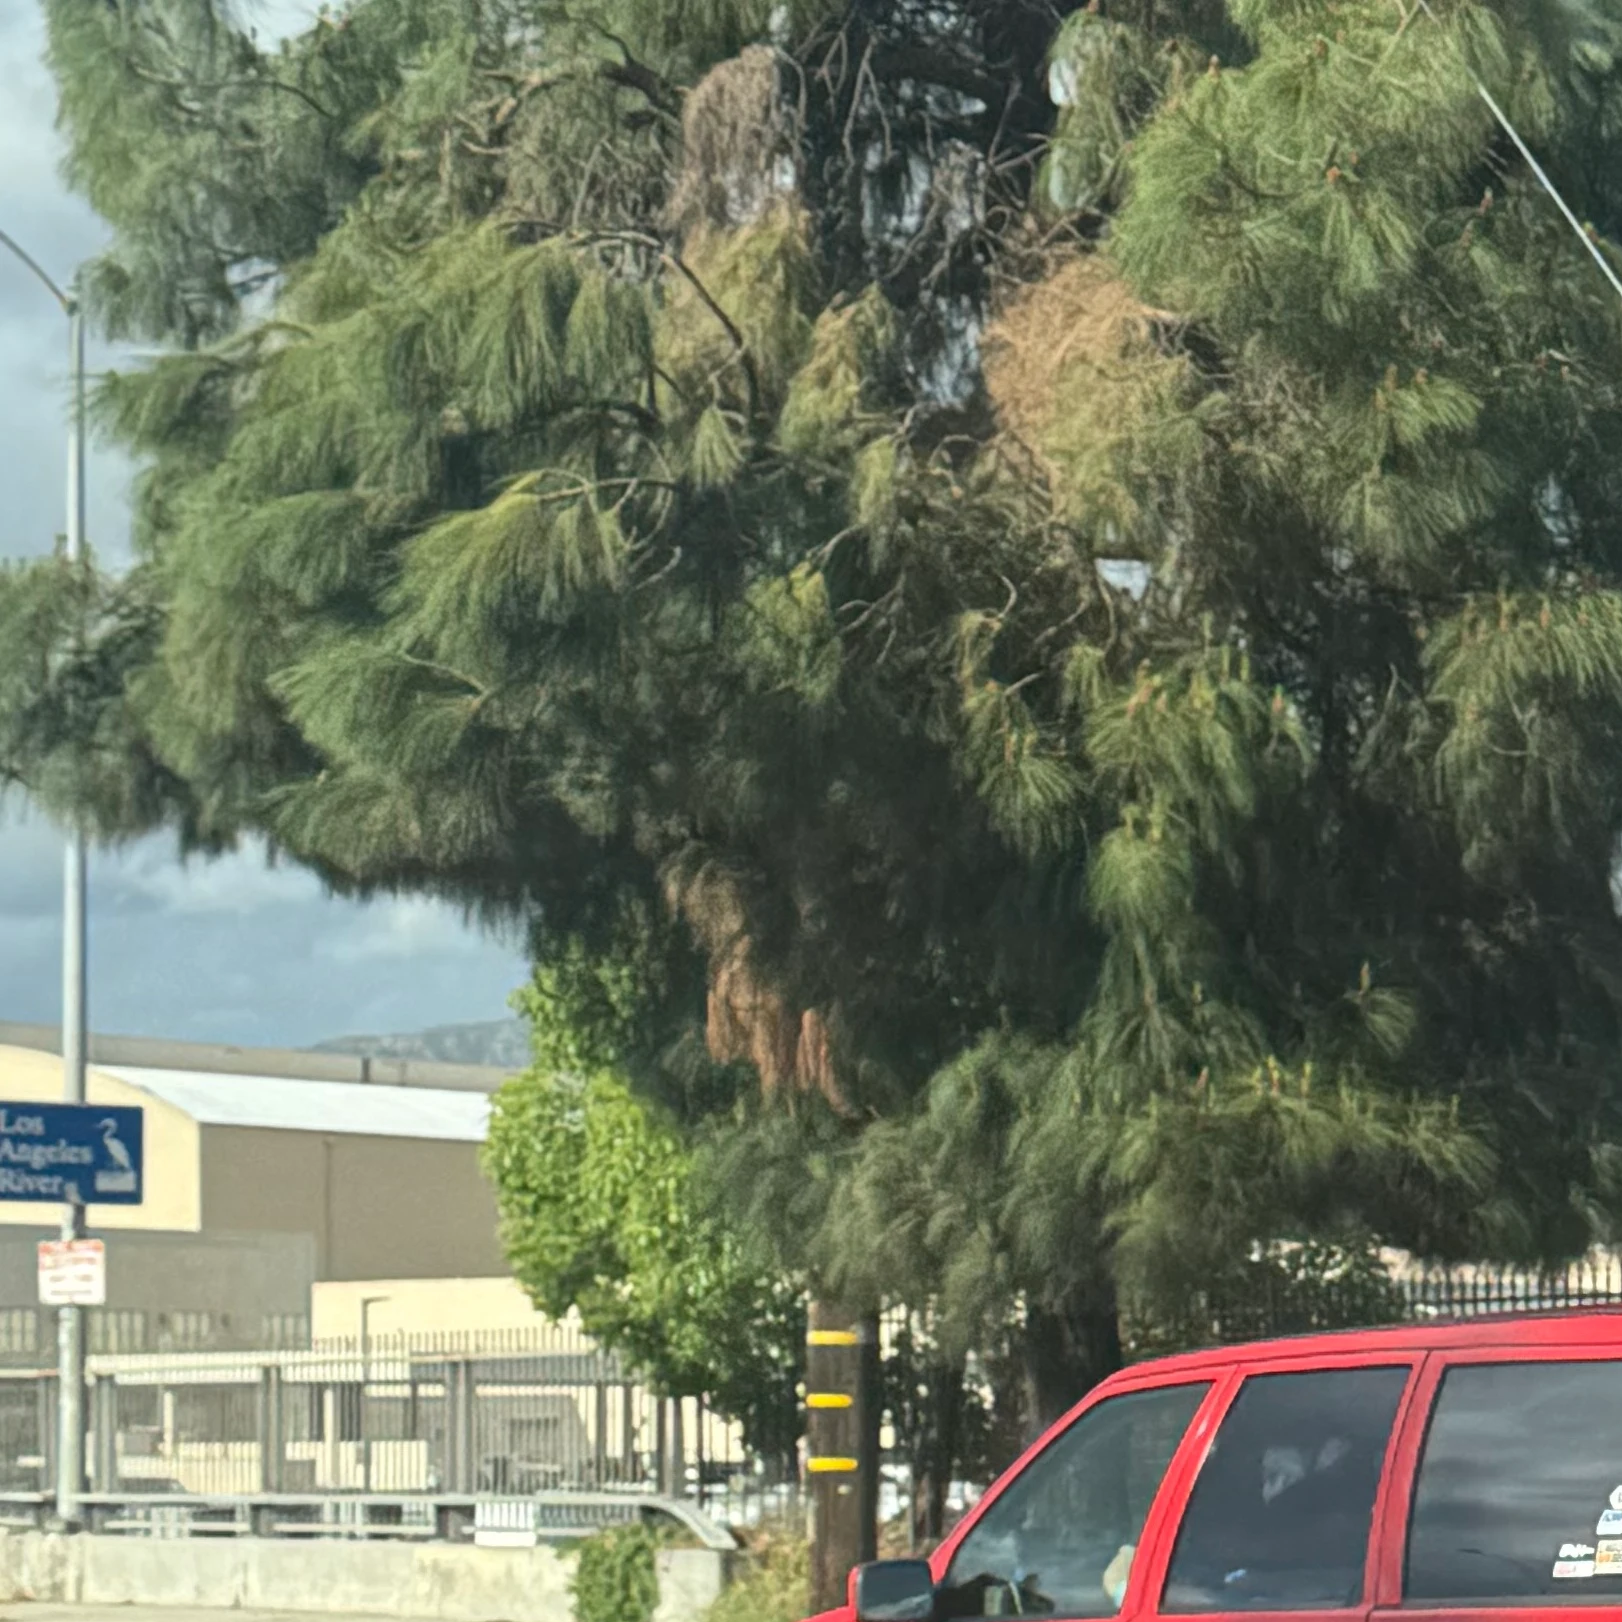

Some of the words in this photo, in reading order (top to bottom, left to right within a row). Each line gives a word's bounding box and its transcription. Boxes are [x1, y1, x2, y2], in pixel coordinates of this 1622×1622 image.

[0, 1109, 45, 1136] Los
[0, 1138, 94, 1170] Angeles
[0, 1168, 63, 1194] River
